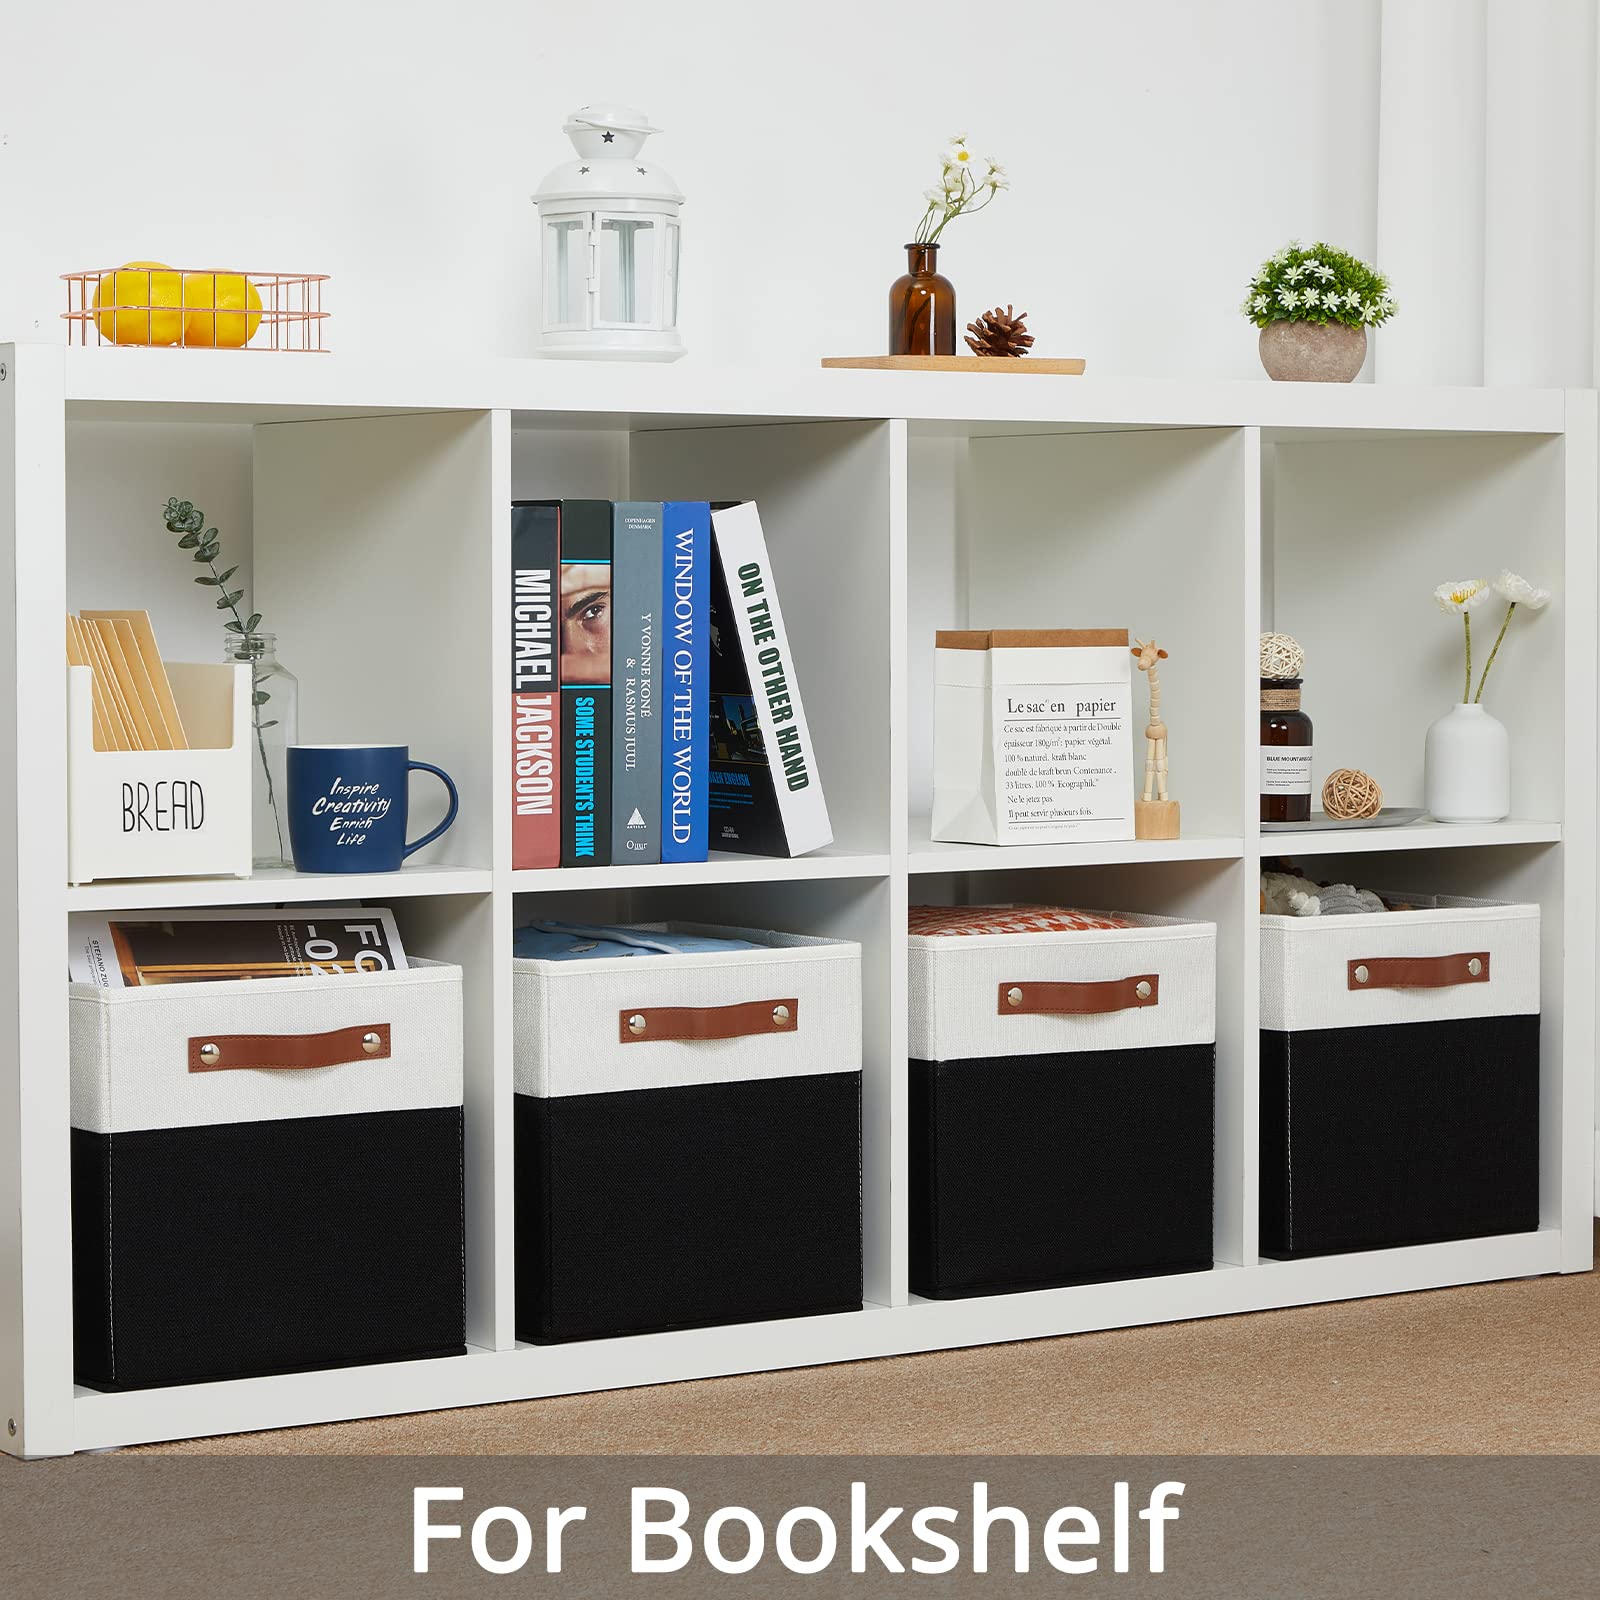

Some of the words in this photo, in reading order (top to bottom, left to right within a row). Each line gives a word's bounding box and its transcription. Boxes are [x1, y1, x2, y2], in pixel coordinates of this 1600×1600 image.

[674, 528, 694, 645] WINDOW
[737, 562, 765, 598] ON
[514, 569, 552, 689] MICHAEL
[746, 598, 776, 646] THE
[626, 657, 636, 668] &
[674, 650, 693, 685] OF
[640, 679, 652, 718] KONÉ
[757, 647, 794, 725] OTHER
[575, 697, 595, 737] SOME
[625, 678, 636, 734] RASMUS
[673, 688, 692, 742] THE
[1007, 698, 1025, 713] Le
[1050, 702, 1065, 712] en
[1076, 698, 1116, 717] papier
[1004, 724, 1013, 733] Ce
[1068, 723, 1087, 734] partir
[1087, 722, 1096, 731] de
[1097, 722, 1122, 731] Double
[1064, 737, 1086, 748] papier
[515, 695, 553, 816] JACKSON
[624, 737, 636, 772] JUUL
[775, 725, 810, 792] HAND
[1004, 754, 1016, 762] 100
[1016, 754, 1024, 762] %
[1051, 752, 1068, 761] kraft
[1068, 752, 1087, 761] blanc
[1029, 767, 1038, 776] de
[1038, 766, 1054, 776] kraft
[329, 777, 380, 798] Inspire
[575, 739, 595, 811] STUDENTS
[1005, 781, 1014, 789] 33
[1035, 780, 1047, 789] 100
[1047, 780, 1055, 788] %
[122, 780, 204, 833] BREAD
[311, 797, 392, 820] Creativity
[672, 745, 692, 844] WORLD
[1008, 795, 1018, 804] Ne
[1018, 794, 1025, 804] le
[329, 817, 373, 831] Enrich
[1014, 810, 1029, 820] peut
[1030, 808, 1049, 818] servir
[1049, 807, 1079, 819] plusieurs
[336, 832, 366, 846] Life
[575, 813, 595, 858] THINK
[92, 940, 105, 972] STEFANO
